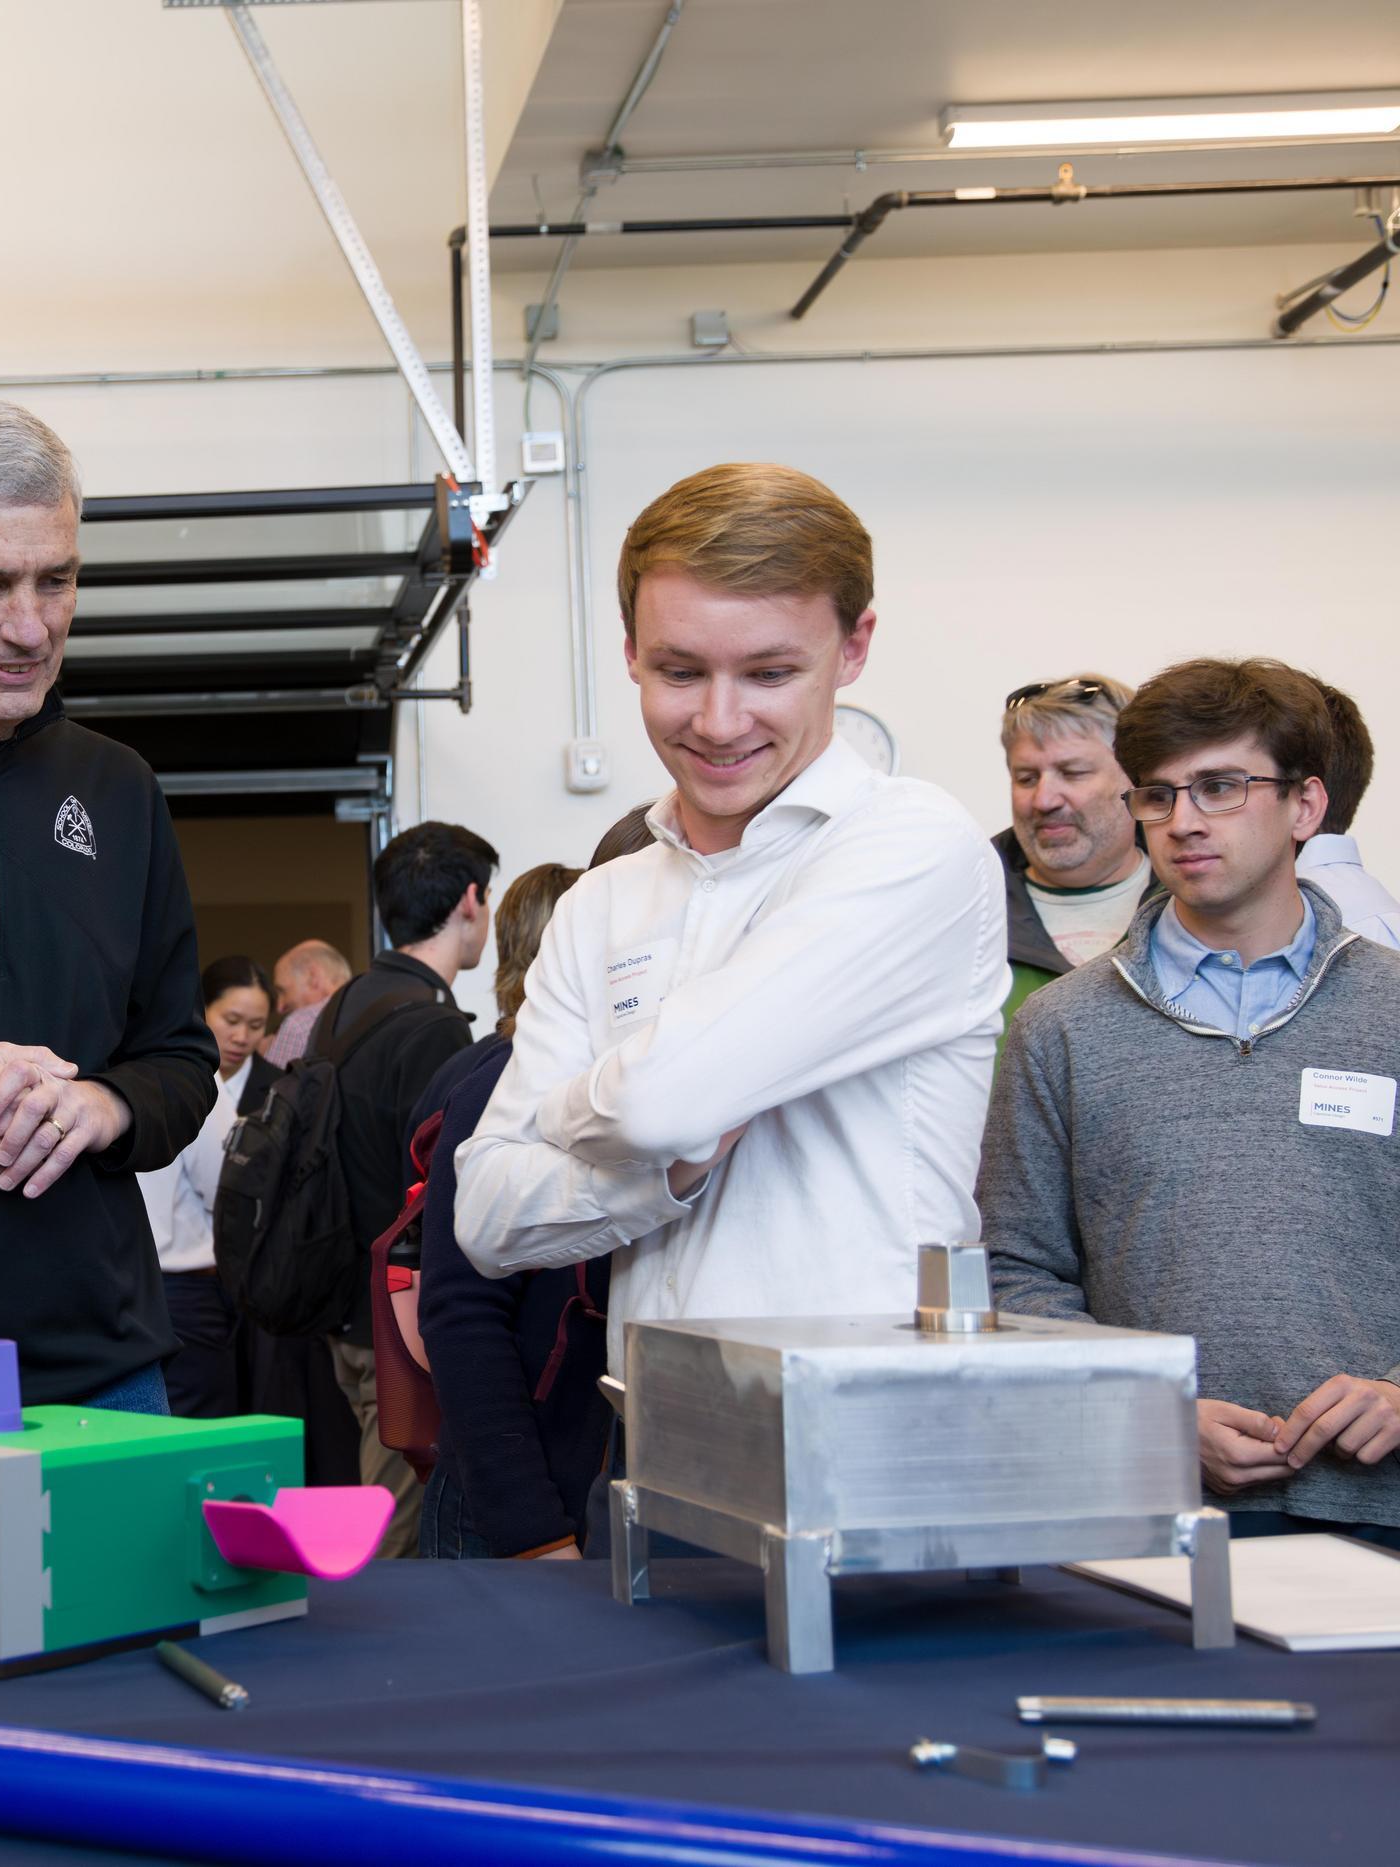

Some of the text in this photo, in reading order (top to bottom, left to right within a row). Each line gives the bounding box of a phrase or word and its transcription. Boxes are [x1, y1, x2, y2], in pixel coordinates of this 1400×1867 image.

[56, 804, 71, 831] SCHOOL
[627, 954, 652, 967] Dupras
[613, 996, 639, 1013] MINES
[1312, 1071, 1368, 1084] Connor Wilde
[1313, 1102, 1351, 1114] MINES
